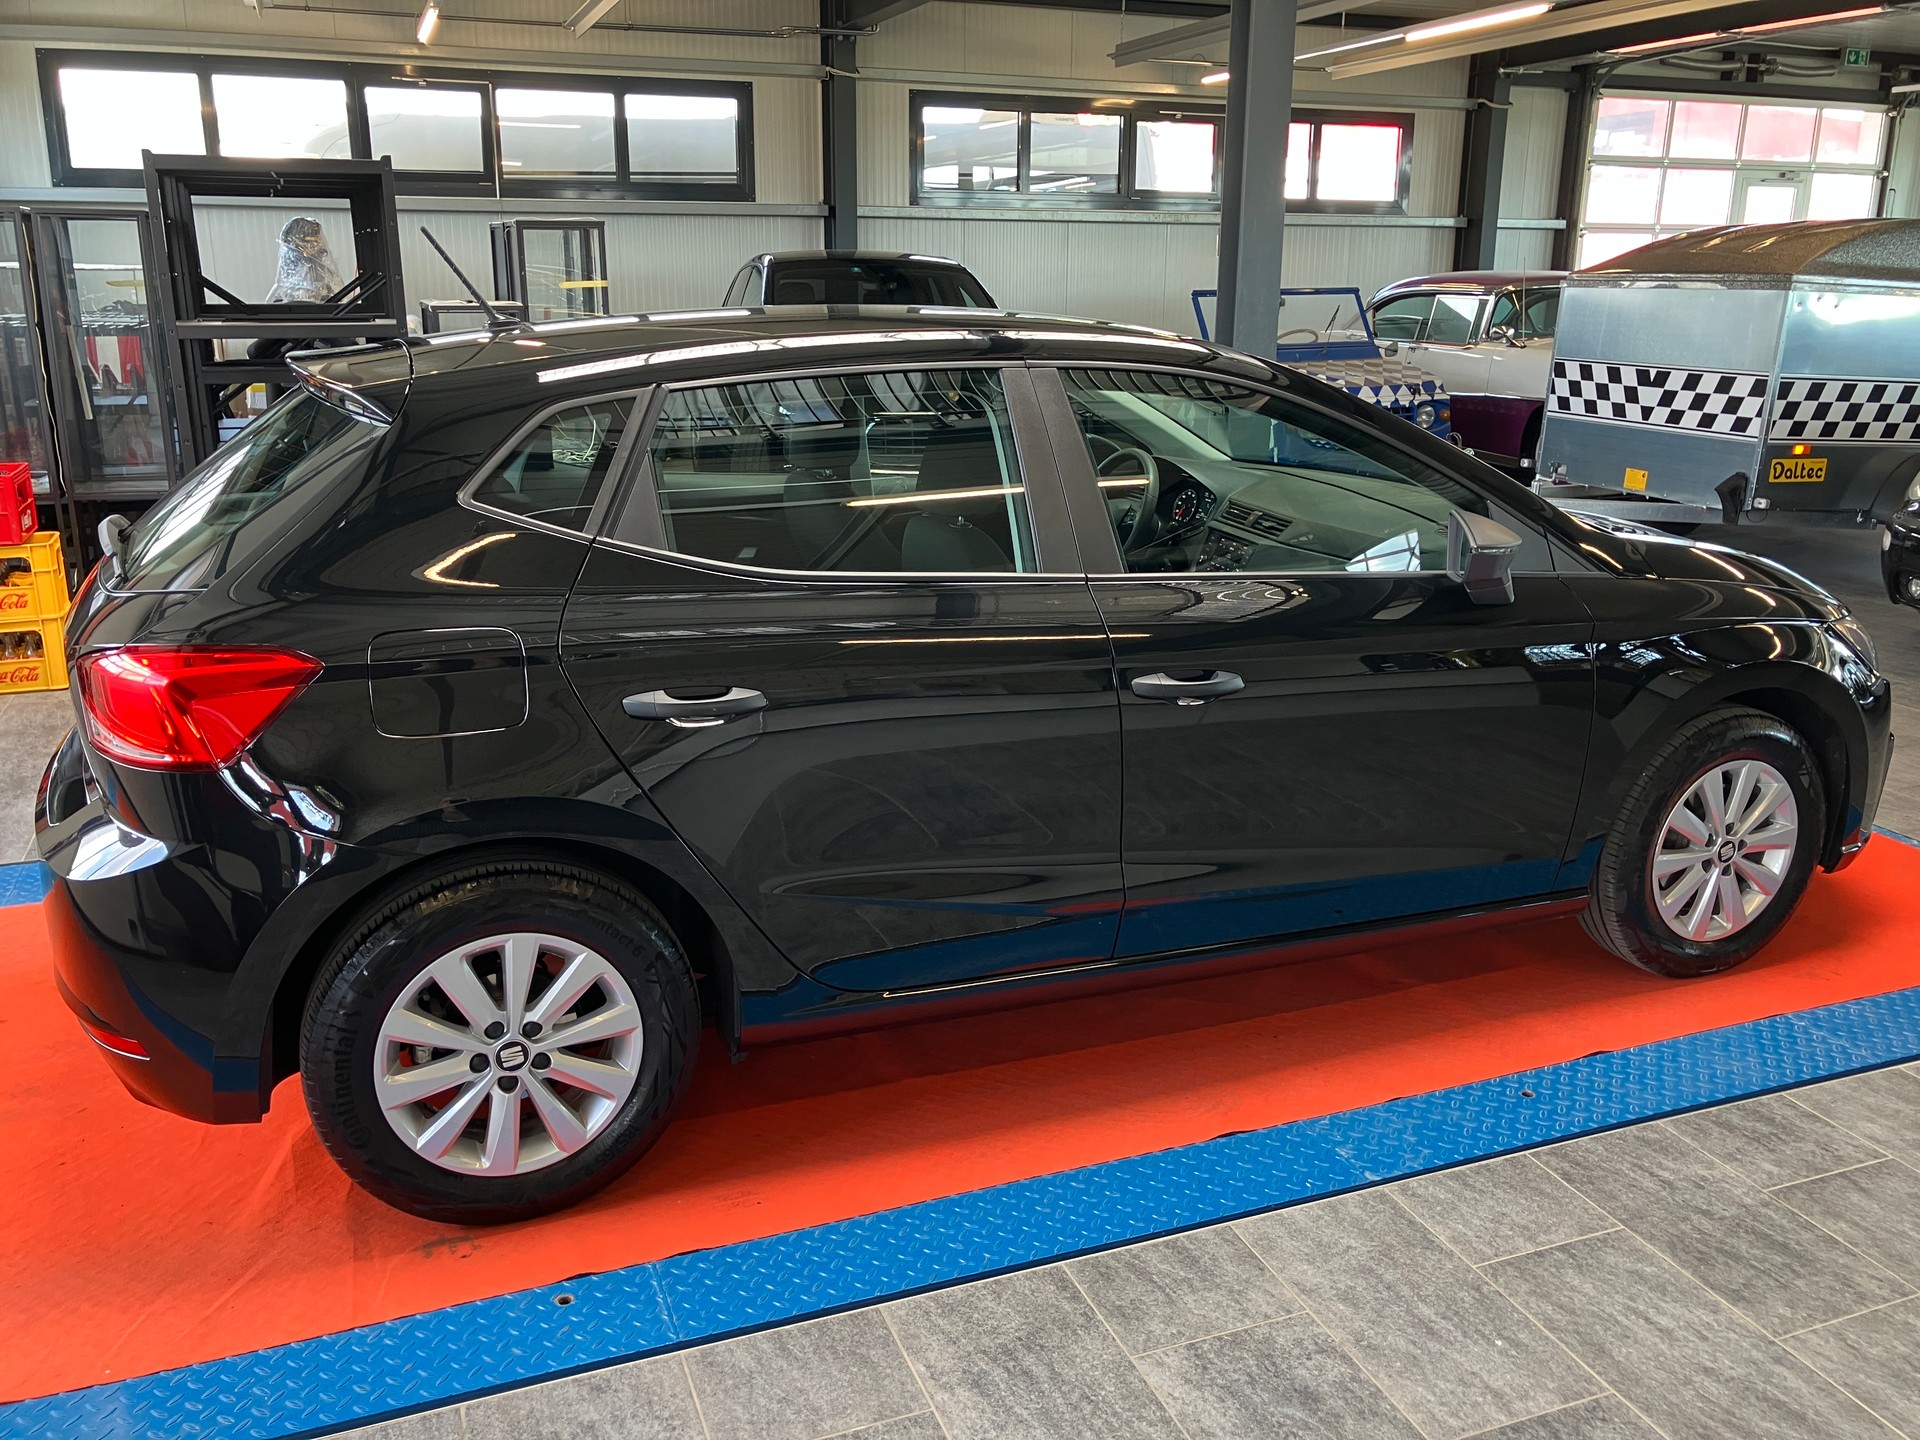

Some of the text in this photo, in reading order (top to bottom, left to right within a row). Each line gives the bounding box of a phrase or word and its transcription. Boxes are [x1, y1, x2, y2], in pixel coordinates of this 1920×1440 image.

[1773, 461, 1823, 479] Daltec
[0, 592, 28, 610] Cola
[0, 665, 40, 683] a-Cola
[331, 1024, 373, 1150] Continental
